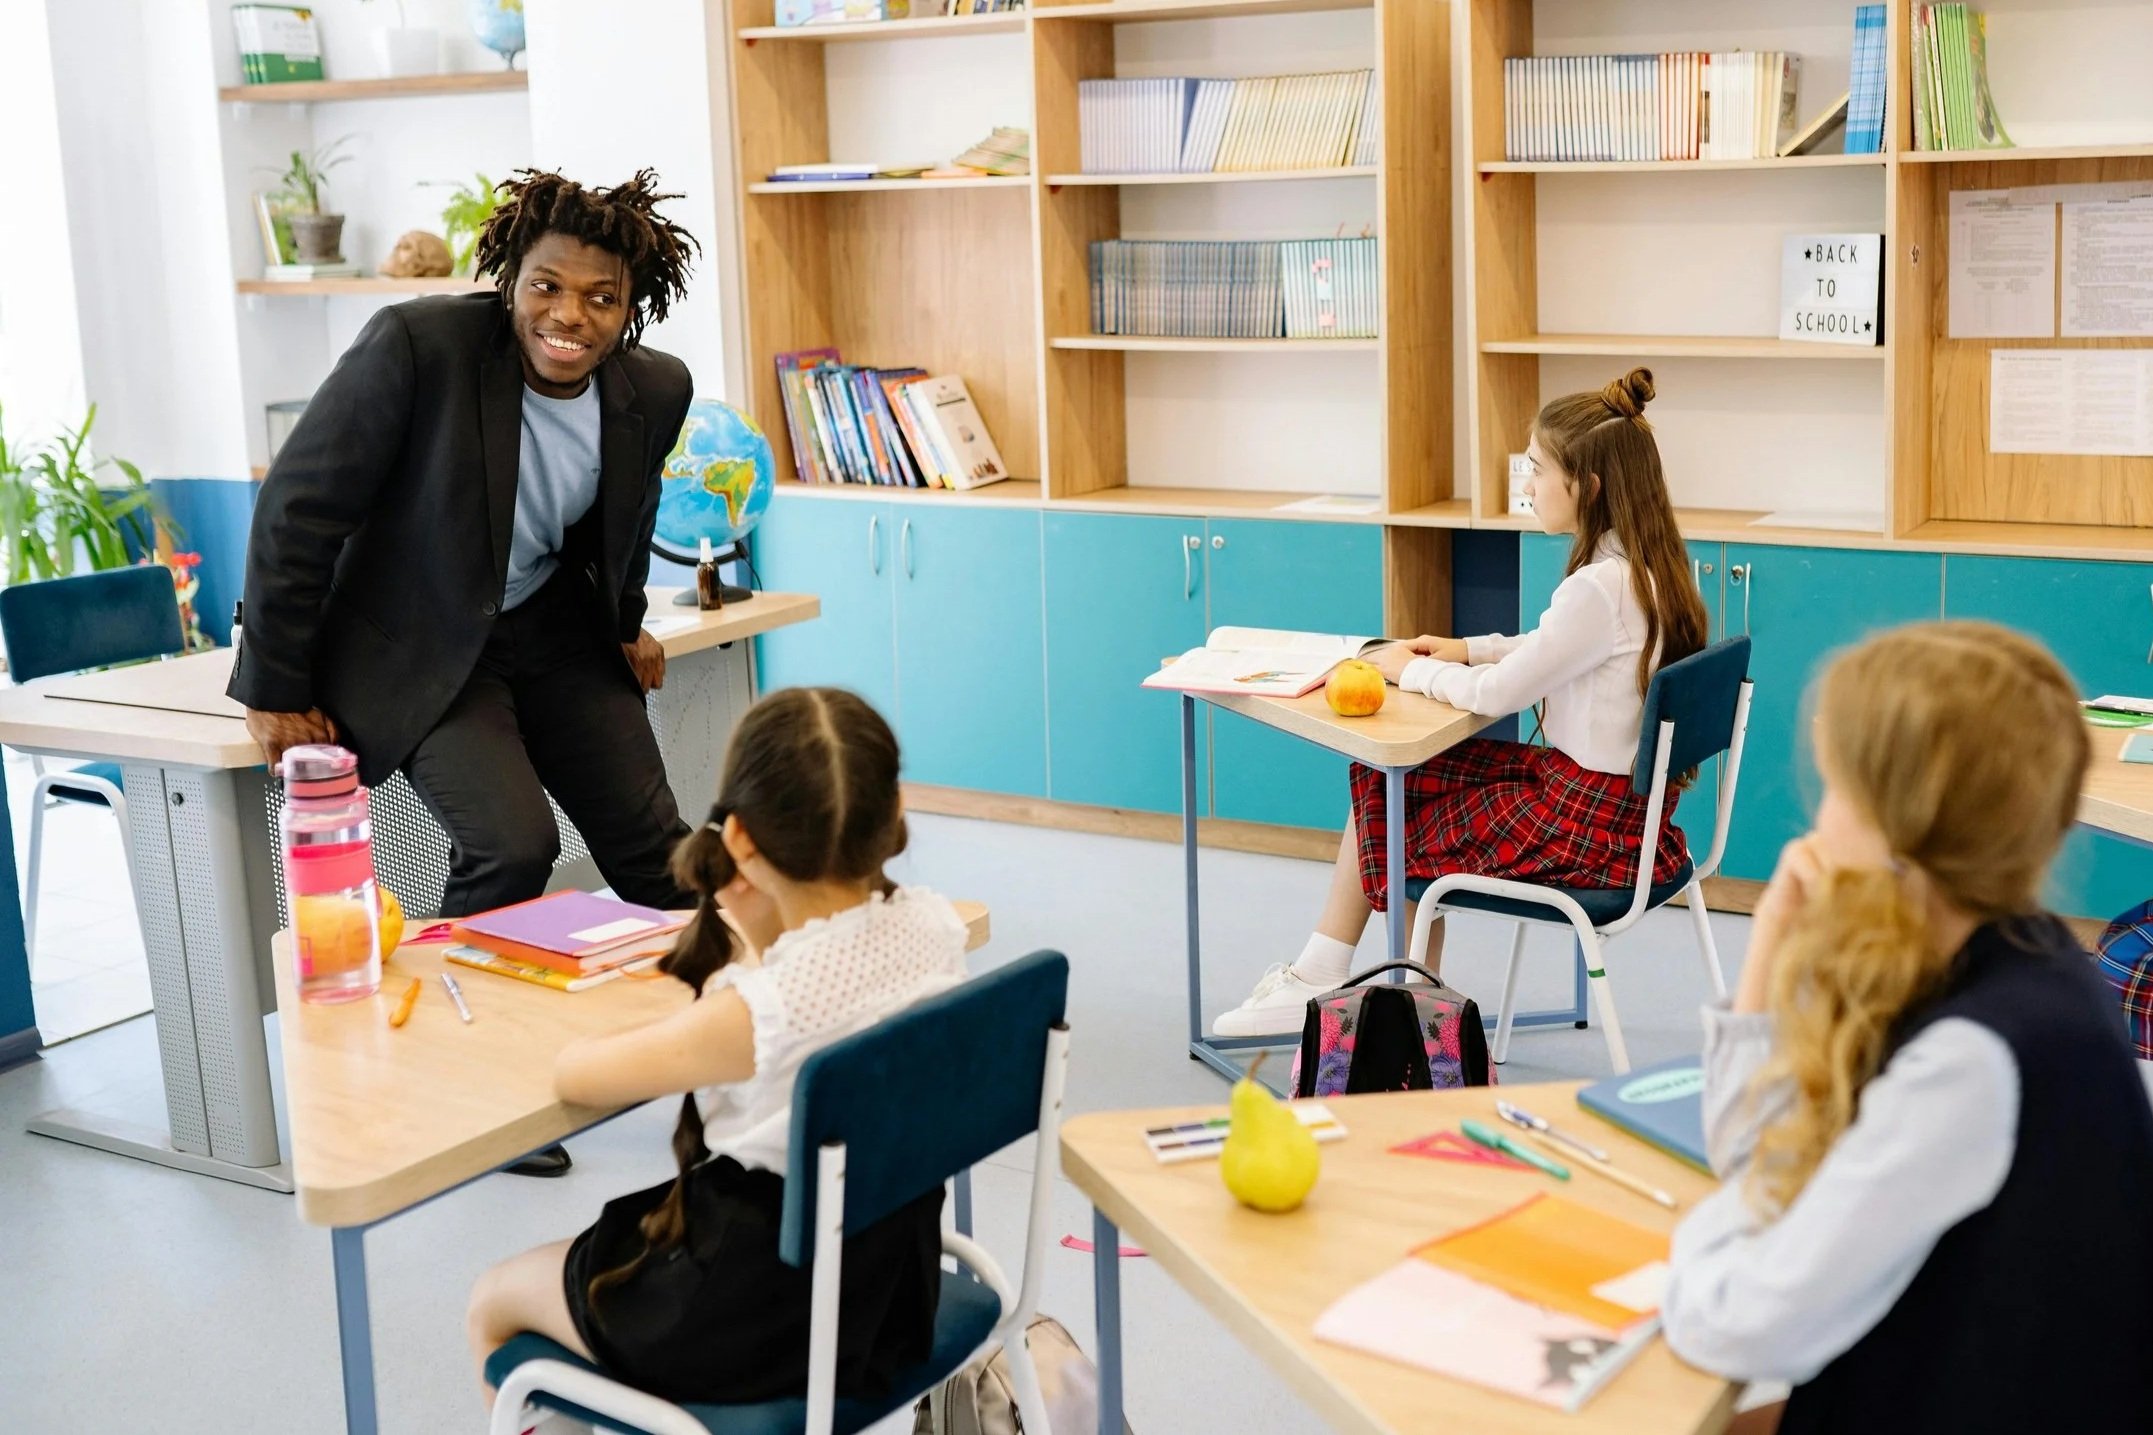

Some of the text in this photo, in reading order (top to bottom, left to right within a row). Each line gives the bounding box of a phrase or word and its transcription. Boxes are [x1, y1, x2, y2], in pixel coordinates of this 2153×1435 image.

[1816, 244, 1857, 263] BACK
[1816, 279, 1836, 298] TO
[1796, 312, 1859, 334] SCHOOL
